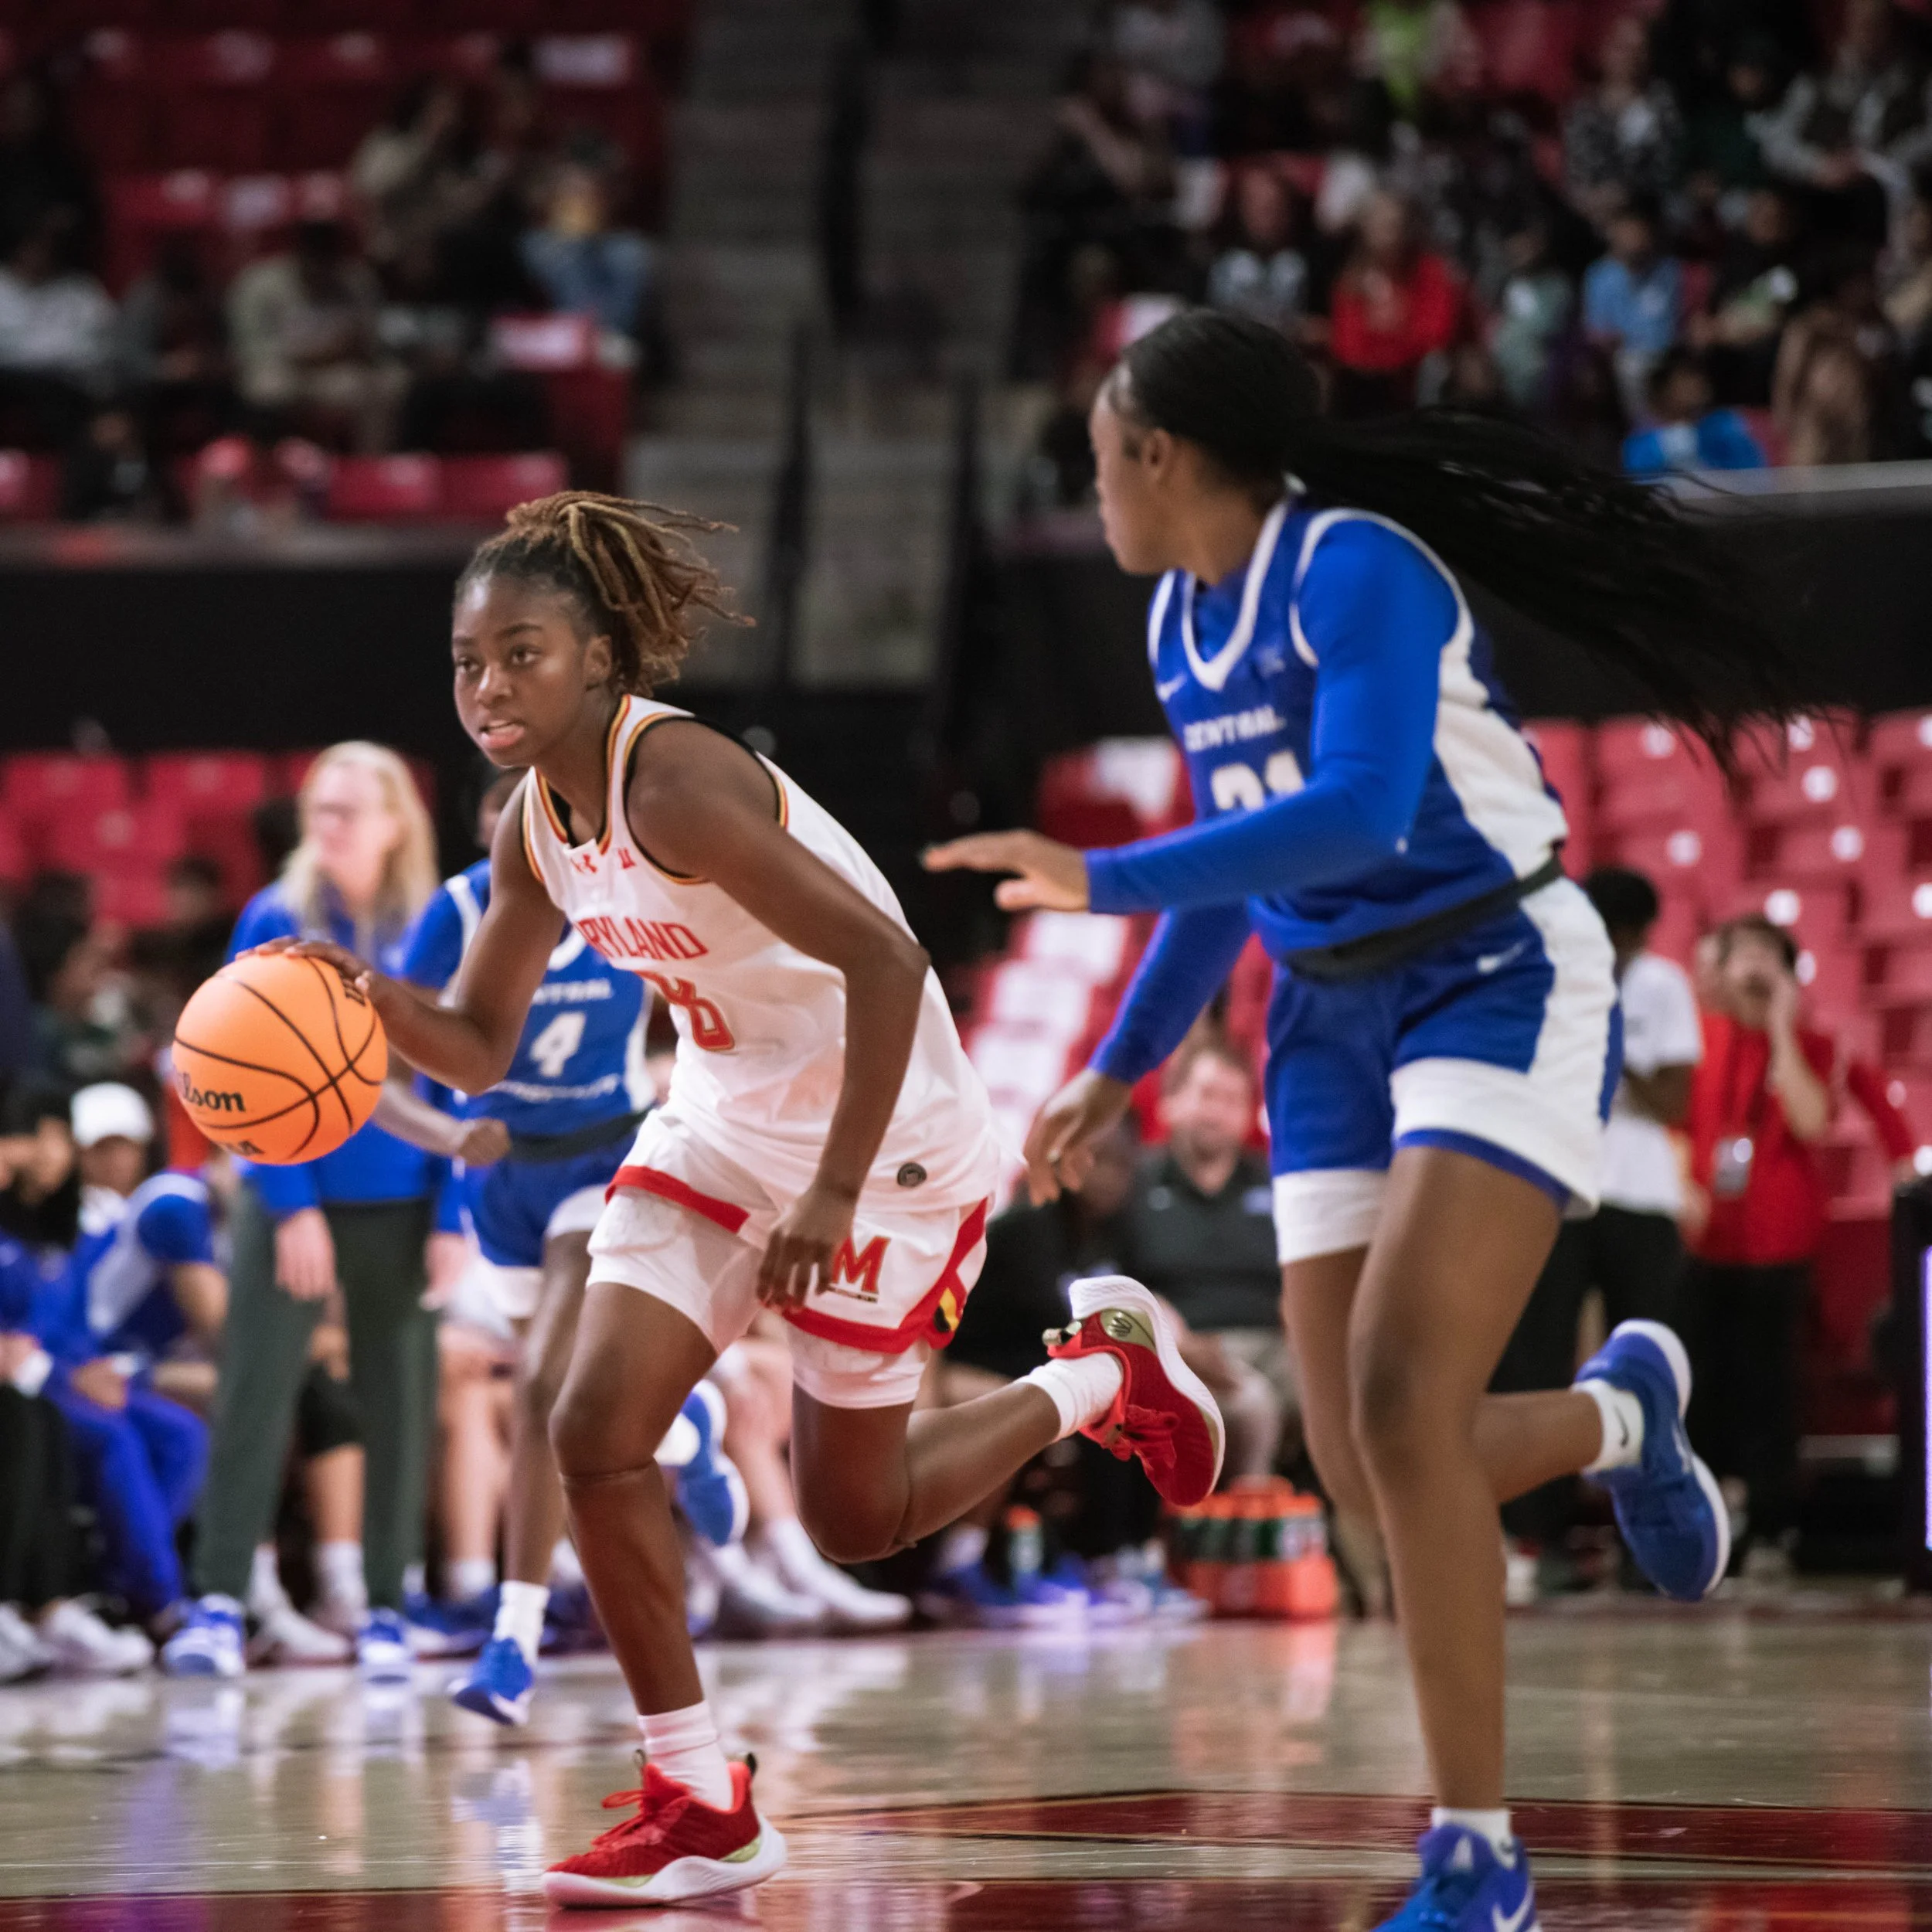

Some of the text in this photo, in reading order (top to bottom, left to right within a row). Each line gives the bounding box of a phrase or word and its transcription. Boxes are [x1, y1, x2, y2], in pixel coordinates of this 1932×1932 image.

[574, 916, 709, 961] RYLAND
[529, 1012, 586, 1077] 4
[177, 1068, 247, 1113] lson
